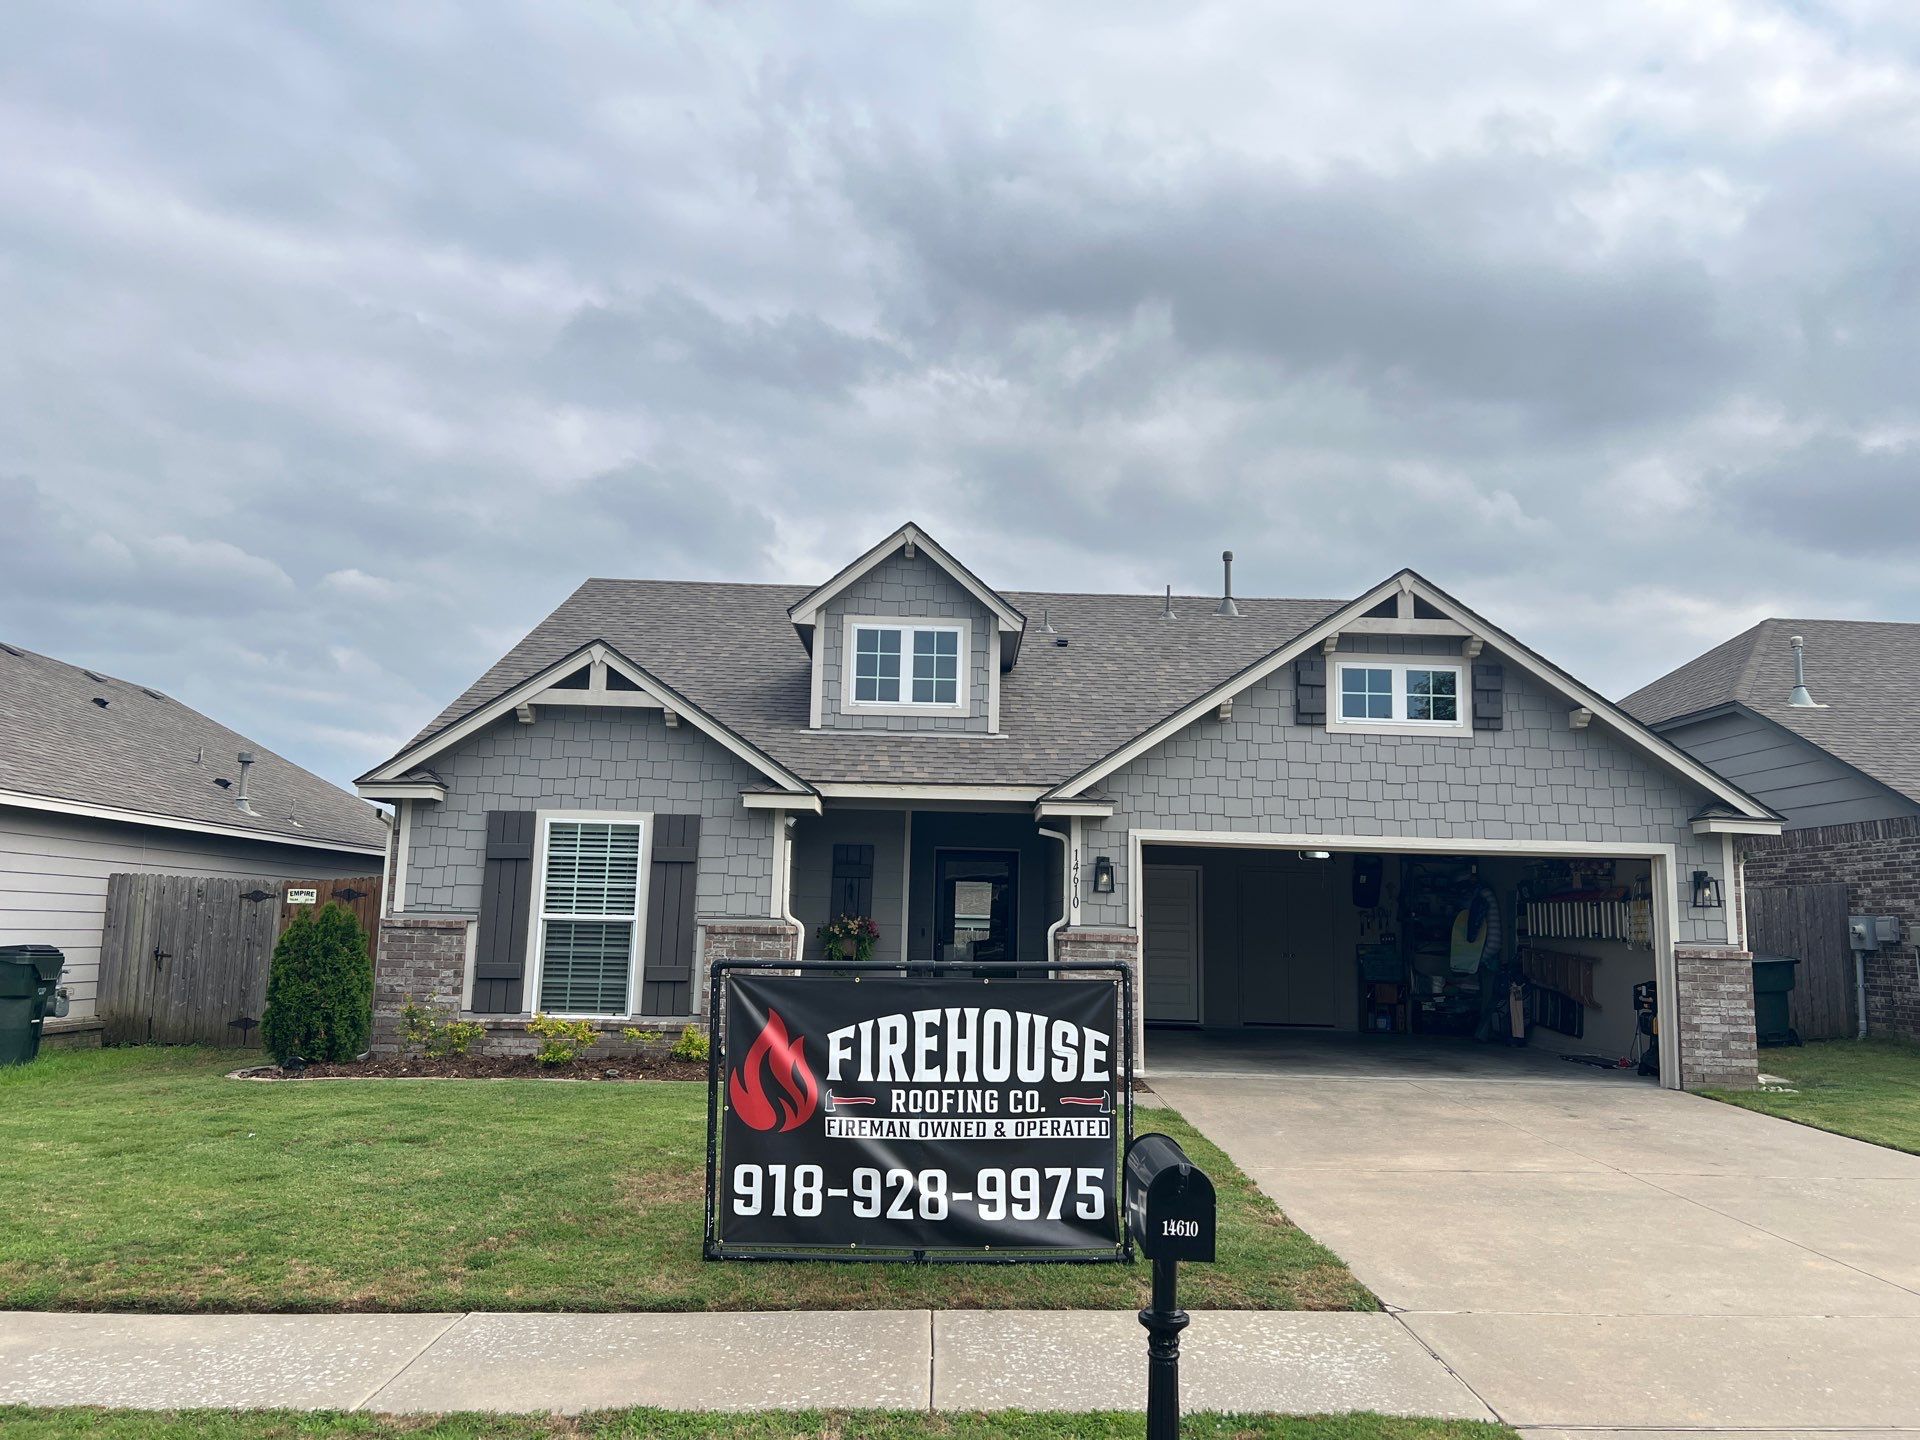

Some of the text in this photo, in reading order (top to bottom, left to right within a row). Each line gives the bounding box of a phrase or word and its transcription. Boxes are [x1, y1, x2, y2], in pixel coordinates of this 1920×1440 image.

[826, 1007, 1110, 1083] FIREHOUSE
[891, 1089, 1046, 1113] ROOFING CO.
[827, 1118, 1109, 1138] FIREMAN OWNED & OPERATED
[733, 1164, 1105, 1221] 918-928-9975
[1162, 1218, 1199, 1237] 14610
